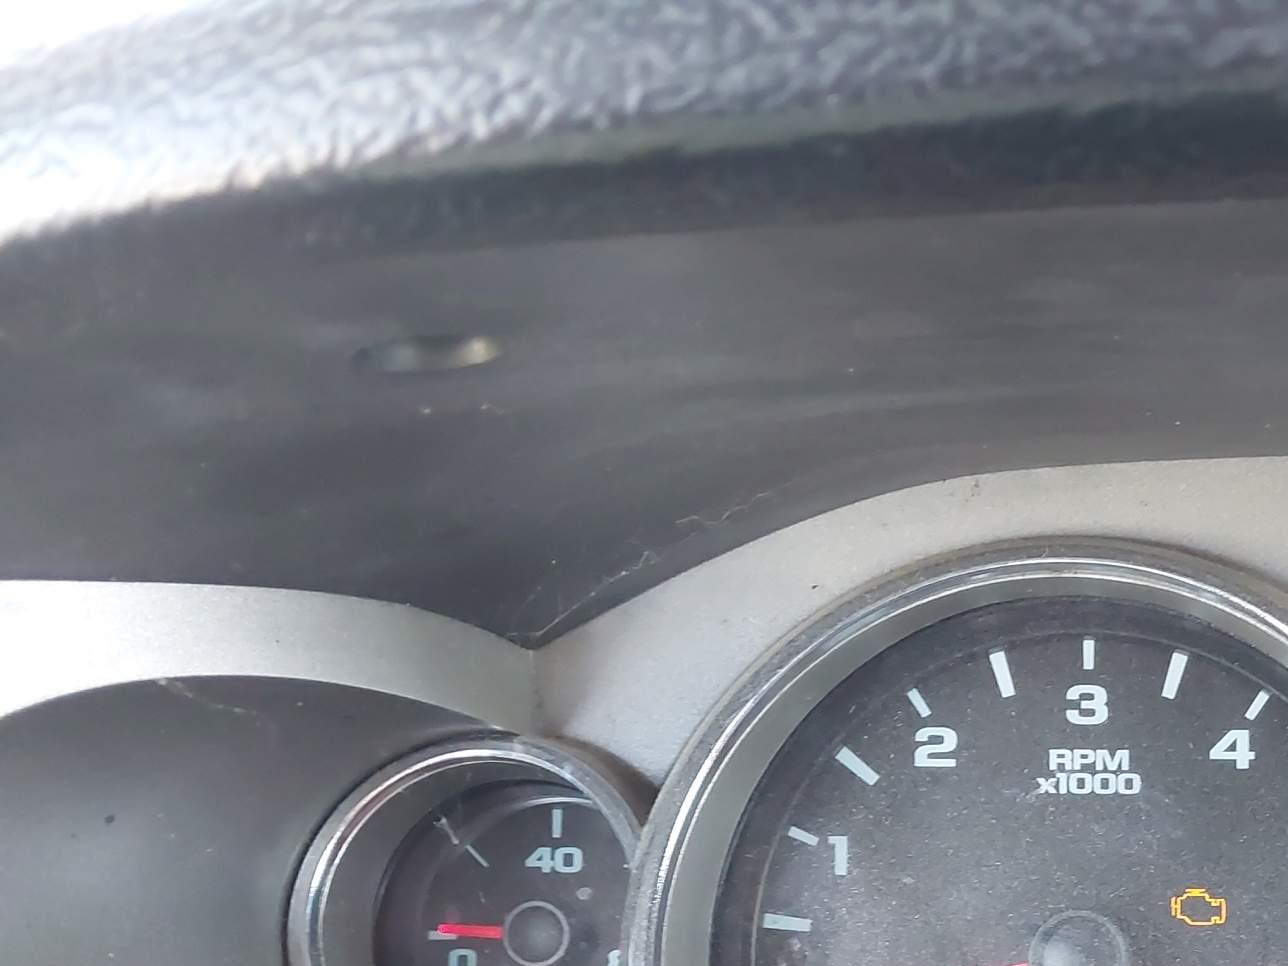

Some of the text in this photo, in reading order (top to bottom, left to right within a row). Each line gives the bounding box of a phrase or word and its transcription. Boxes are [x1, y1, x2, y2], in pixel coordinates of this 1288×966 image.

[1064, 684, 1109, 726] 3
[913, 727, 958, 768] 2
[1048, 749, 1130, 771] RPM
[1208, 729, 1256, 769] 4
[1035, 772, 1141, 796] x1000
[525, 847, 584, 873] 40
[827, 835, 849, 876] 1
